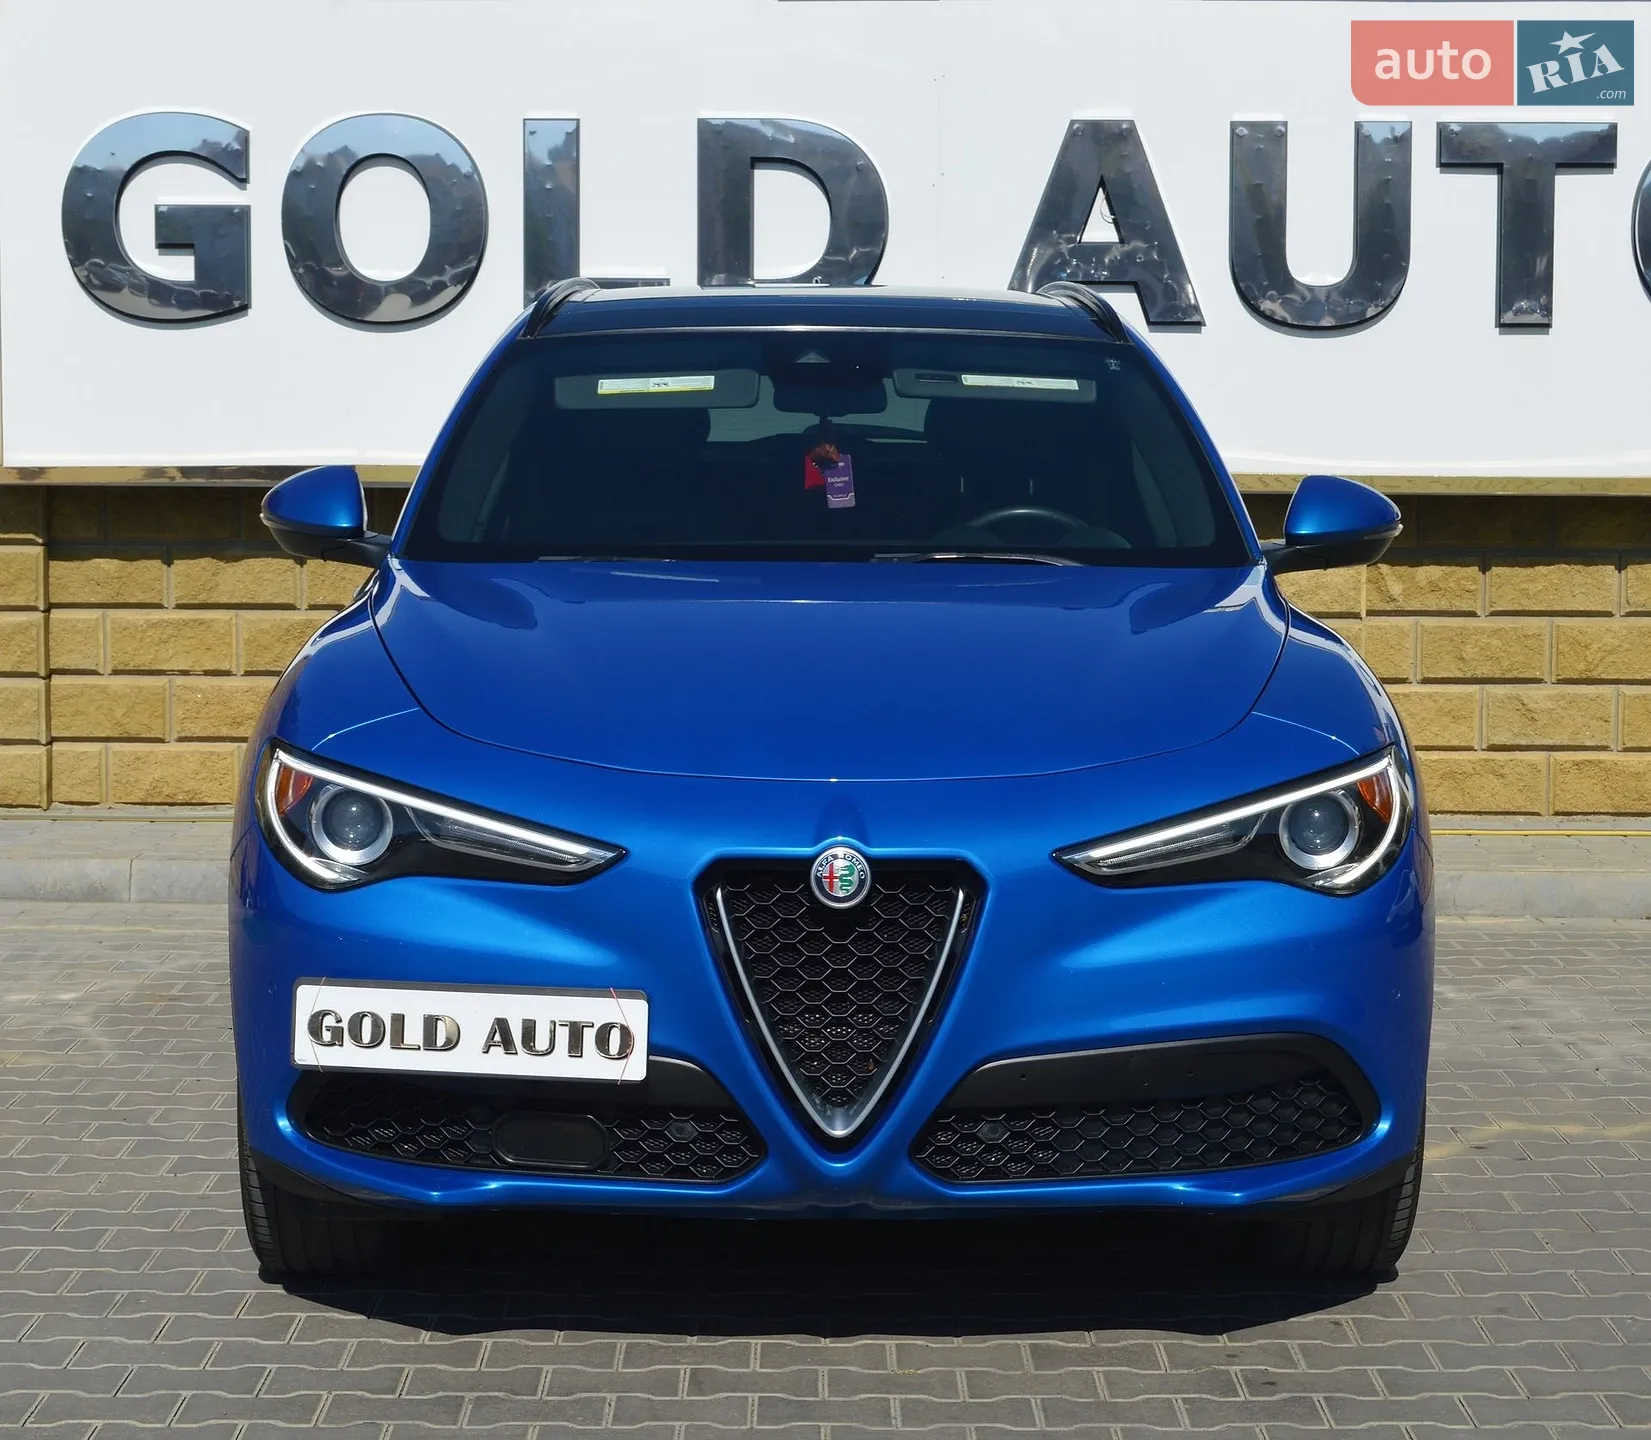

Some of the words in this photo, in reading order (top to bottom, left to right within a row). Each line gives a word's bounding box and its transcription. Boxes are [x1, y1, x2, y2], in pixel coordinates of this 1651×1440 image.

[61, 111, 891, 328] GOLD
[1010, 118, 1651, 331] AUT
[816, 855, 834, 878] ALFA
[307, 1009, 461, 1052] GOLD
[482, 1017, 635, 1060] AUTO
